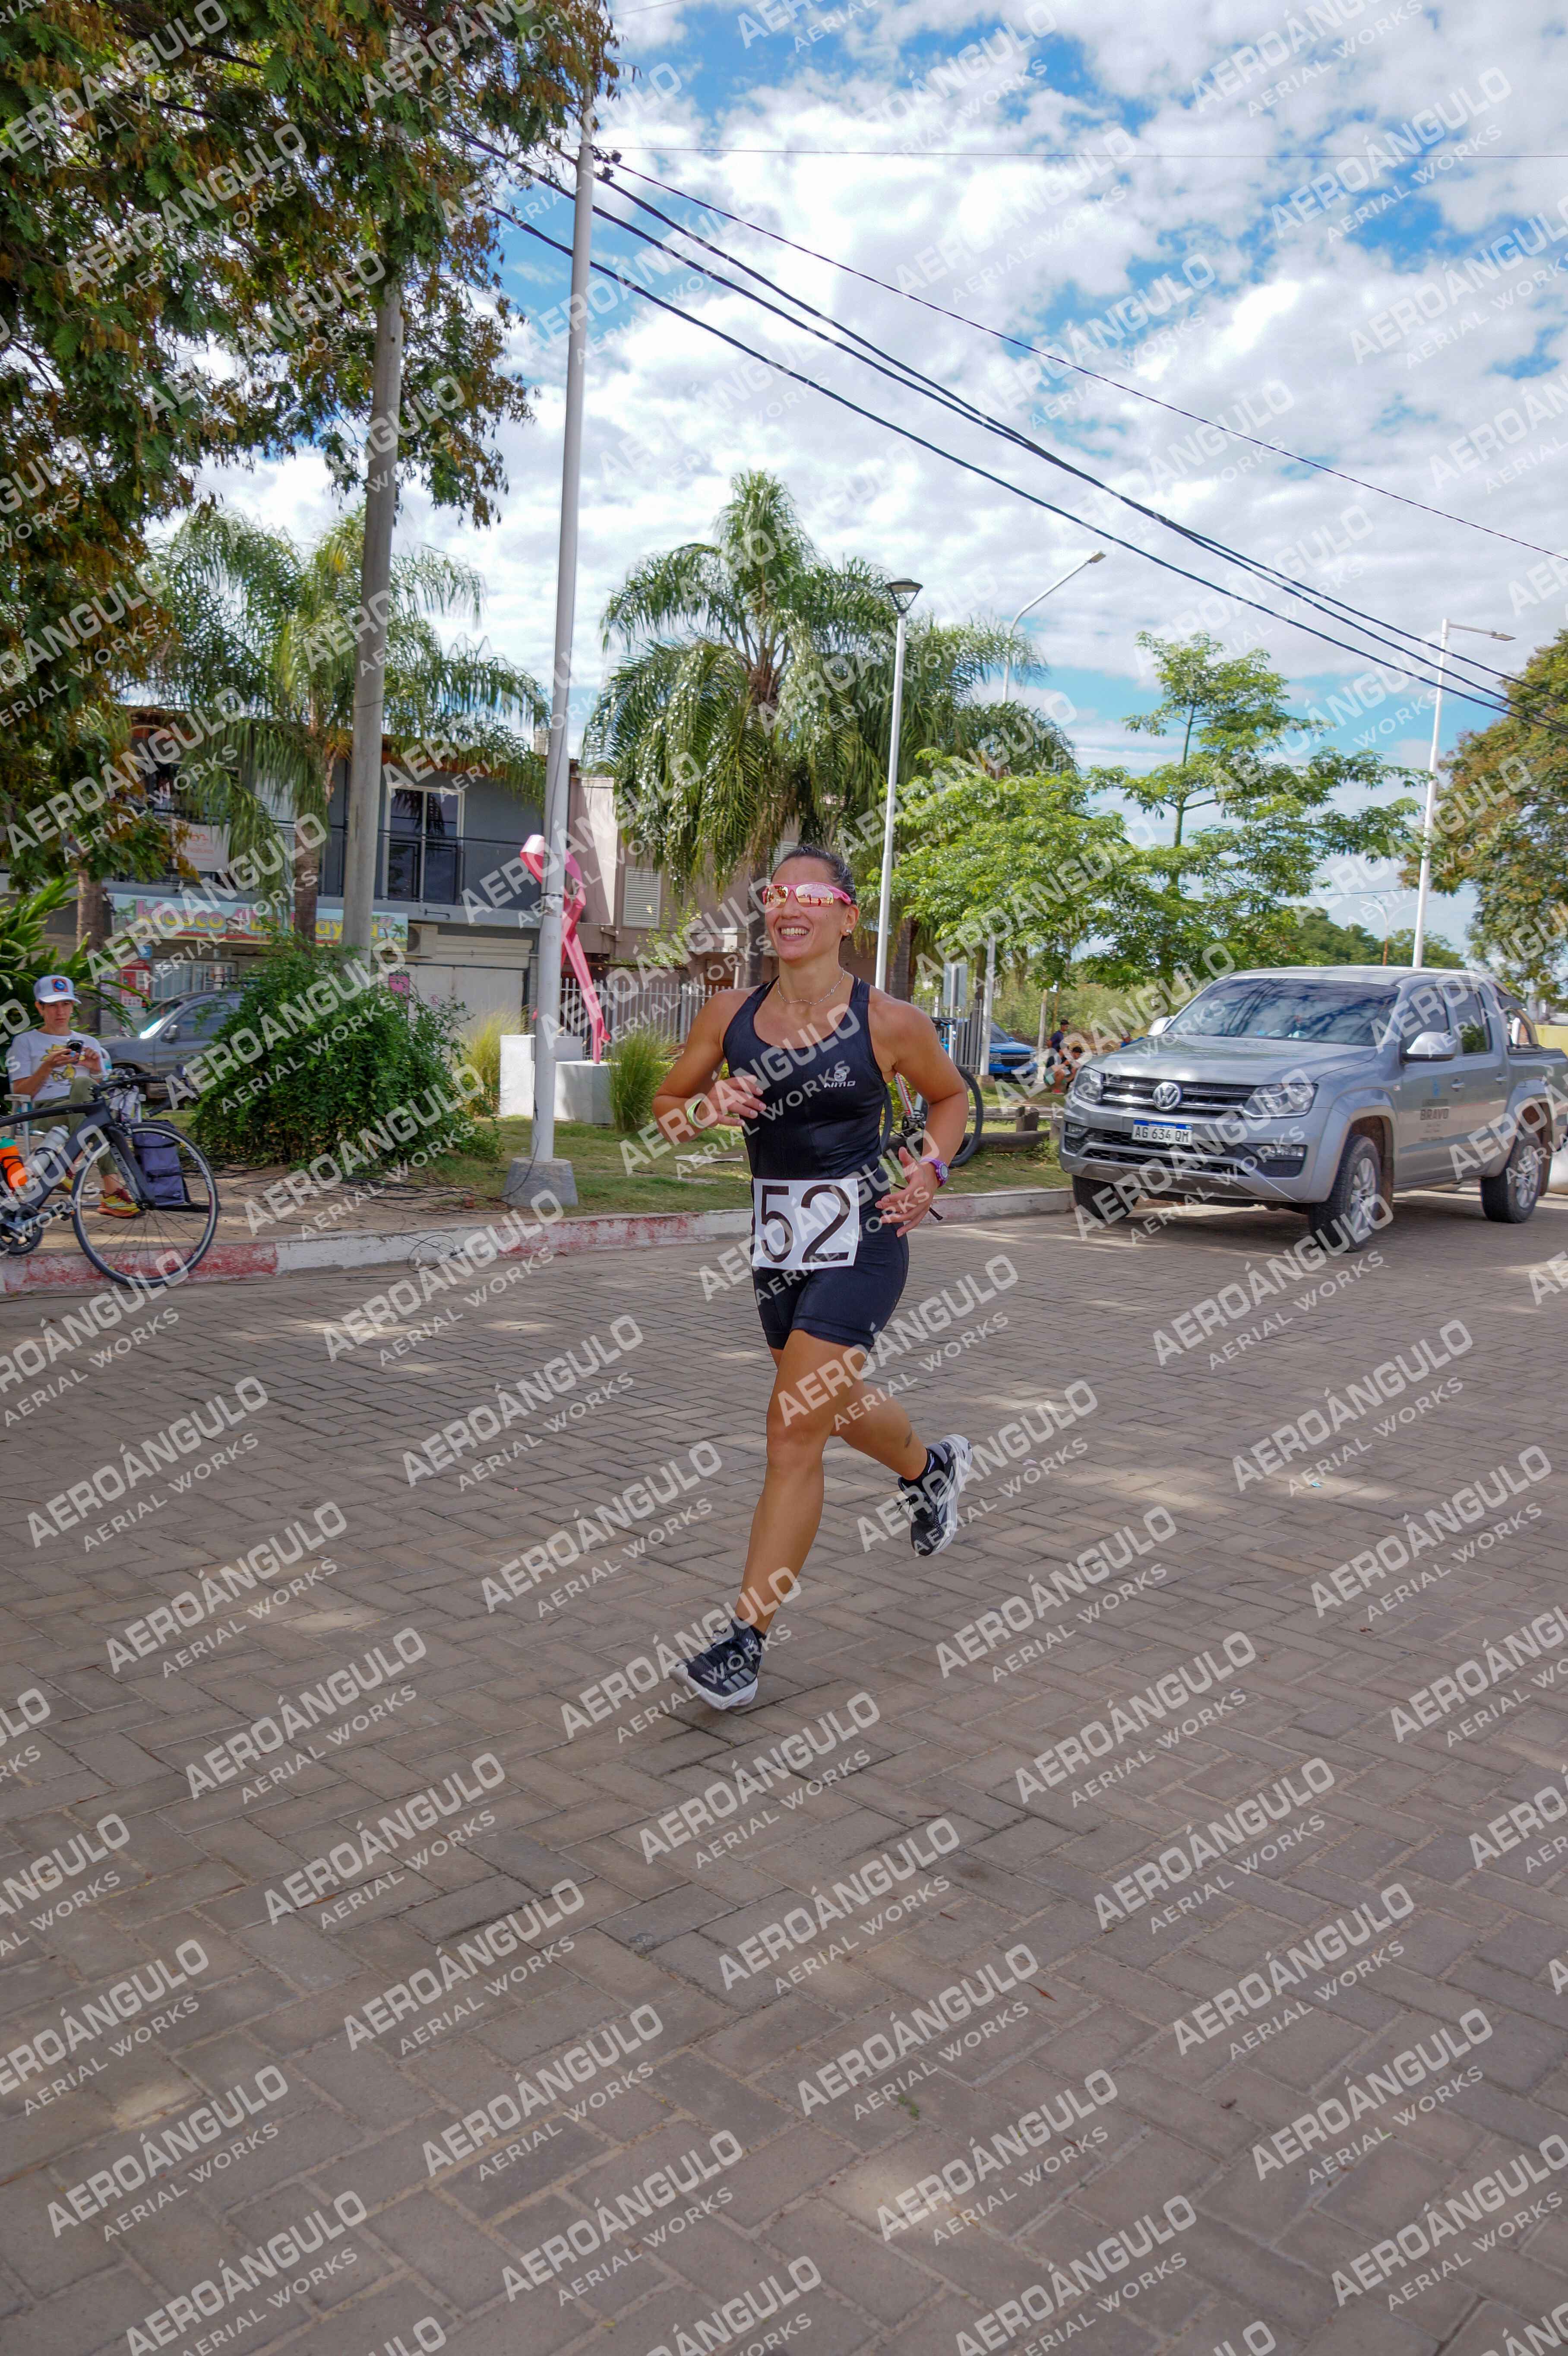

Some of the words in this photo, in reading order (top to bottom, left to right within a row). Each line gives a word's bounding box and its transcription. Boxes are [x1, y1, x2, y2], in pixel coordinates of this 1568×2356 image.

[1419, 1108, 1449, 1121] BRAVO
[1135, 1126, 1149, 1138] AG
[1151, 1128, 1171, 1140] 634
[761, 1184, 851, 1263] 52
